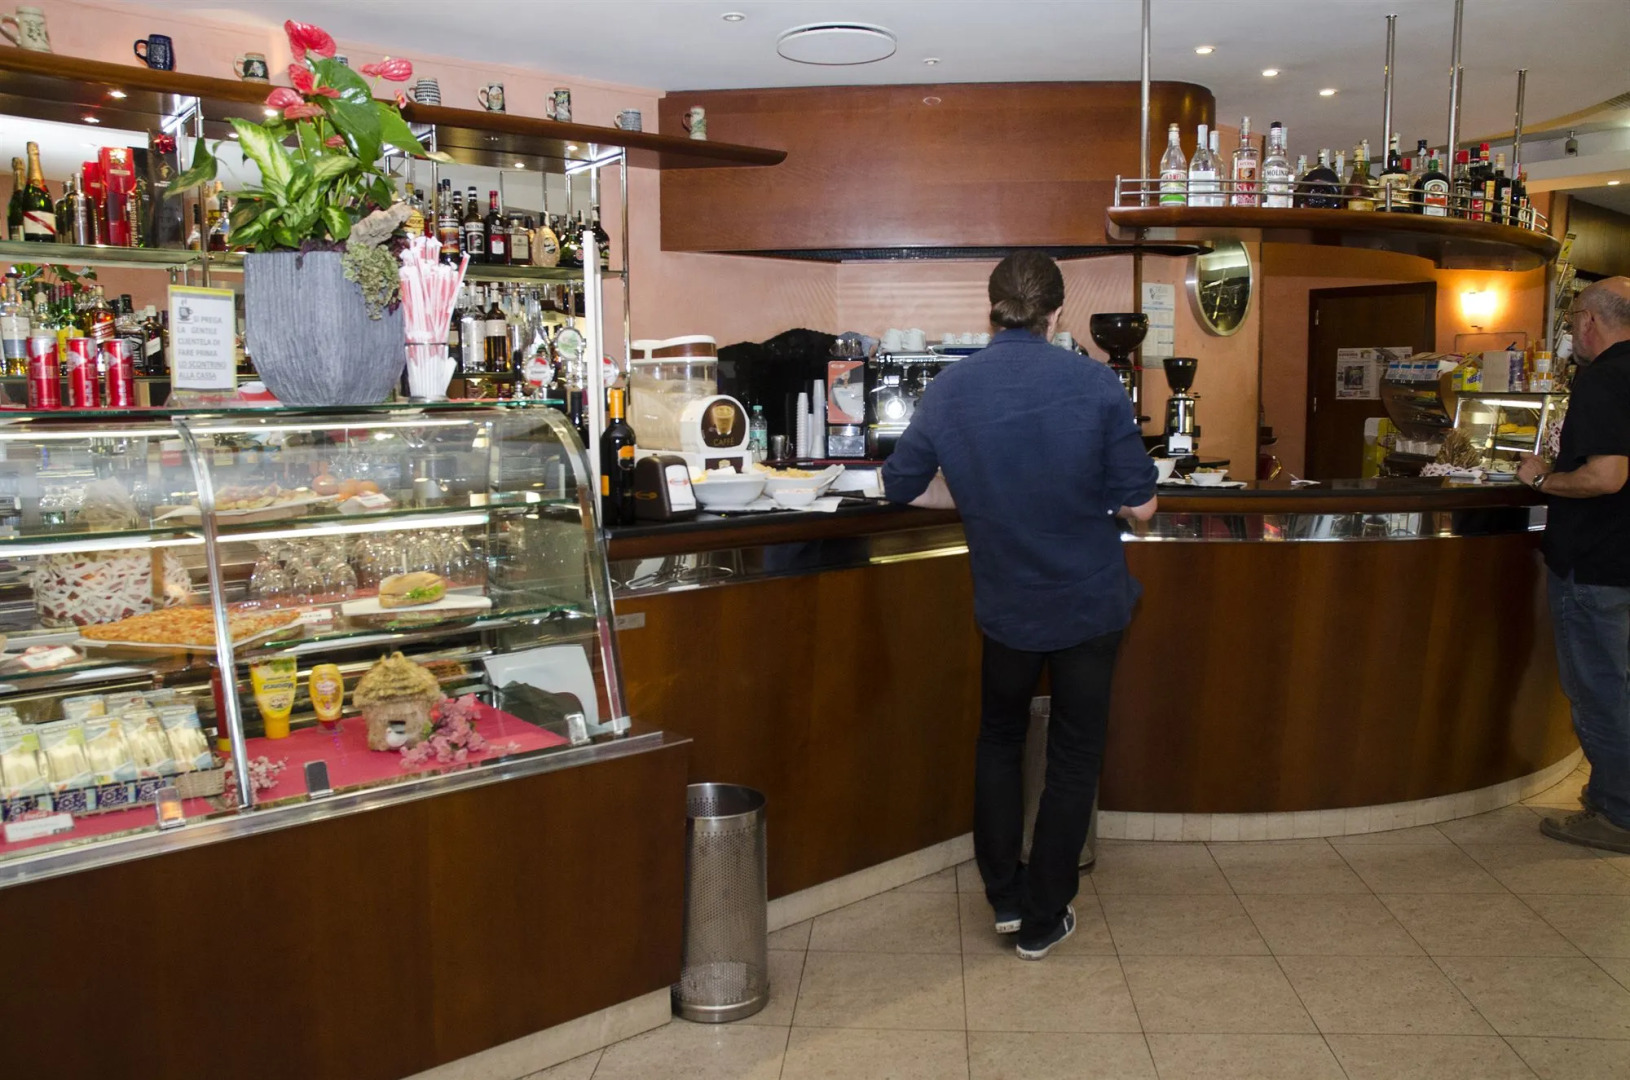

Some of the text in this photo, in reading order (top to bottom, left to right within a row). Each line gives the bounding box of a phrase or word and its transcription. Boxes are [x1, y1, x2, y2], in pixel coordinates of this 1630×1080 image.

[201, 316, 223, 324] PREGA
[191, 327, 217, 335] GENTILE
[177, 338, 211, 346] CLIENTELA
[178, 349, 218, 357] FARE PRIMA
[178, 361, 227, 370] LO SCONTRINO
[178, 372, 217, 380] ALLA CASSA
